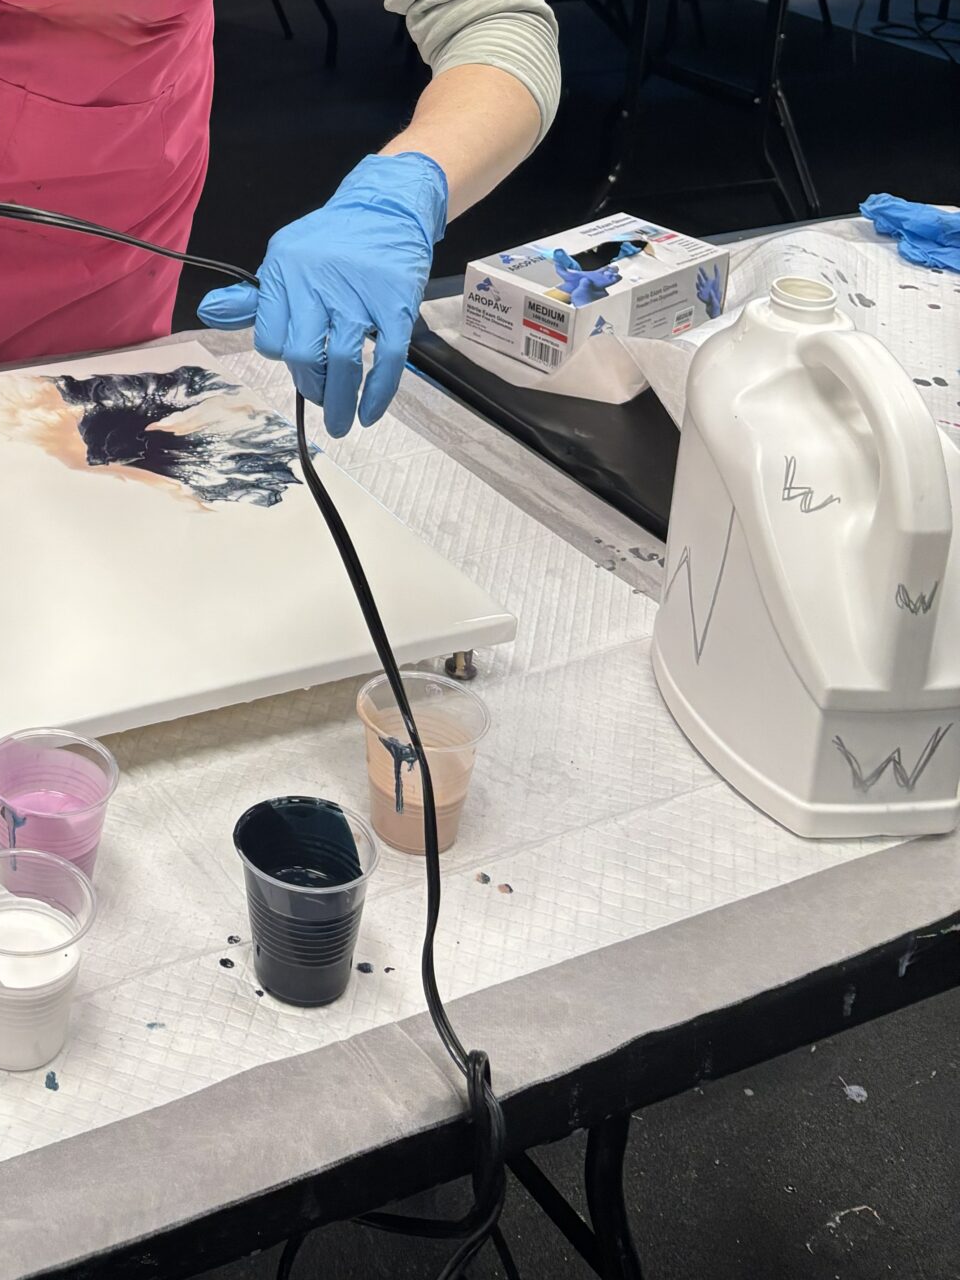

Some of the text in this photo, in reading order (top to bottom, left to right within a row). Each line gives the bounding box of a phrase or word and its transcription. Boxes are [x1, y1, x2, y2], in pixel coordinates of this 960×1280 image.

[468, 291, 510, 315] AROPAW
[528, 301, 566, 323] MEDIUM
[832, 722, 955, 794] W
